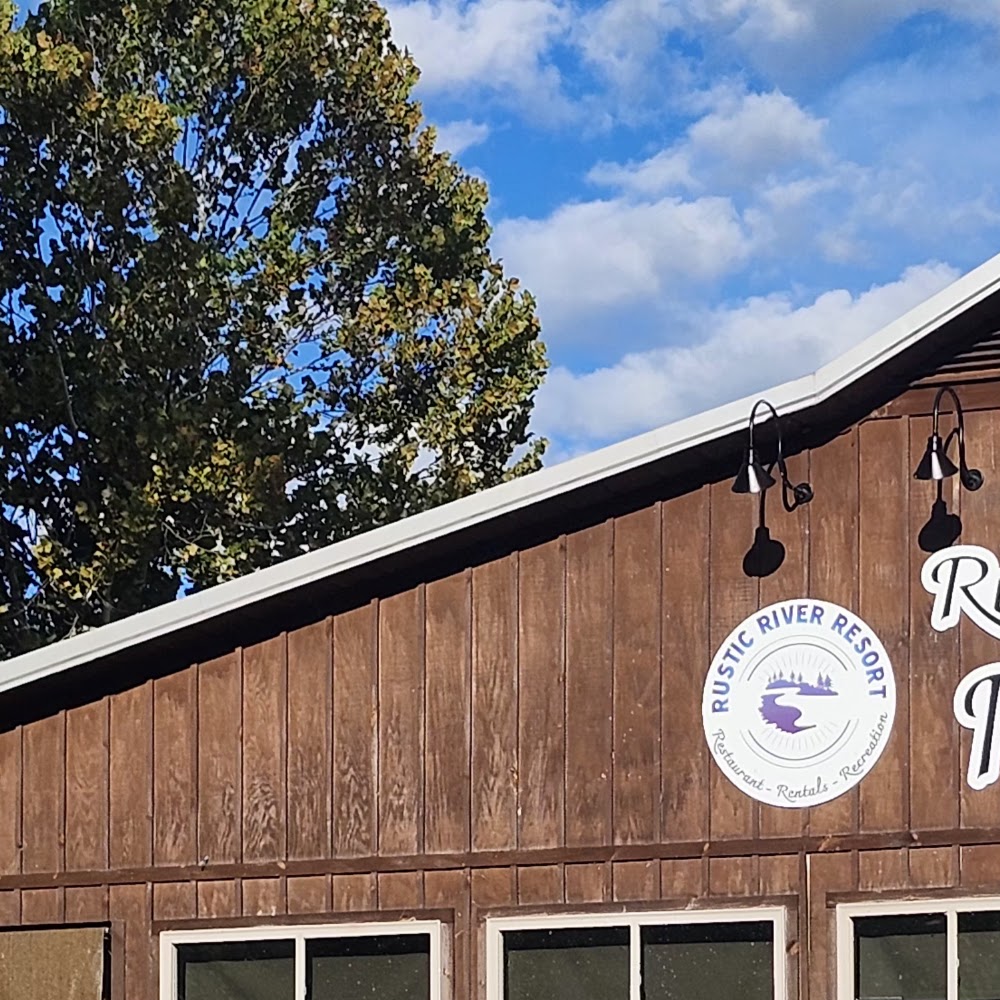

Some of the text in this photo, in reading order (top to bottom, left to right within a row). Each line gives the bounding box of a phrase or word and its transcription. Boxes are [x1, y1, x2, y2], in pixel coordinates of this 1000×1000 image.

[711, 604, 887, 713] RUSTIC RIVER RESORT
[712, 728, 764, 791] Restaurant
[776, 776, 829, 803] Rentals
[839, 711, 888, 781] Recreation
